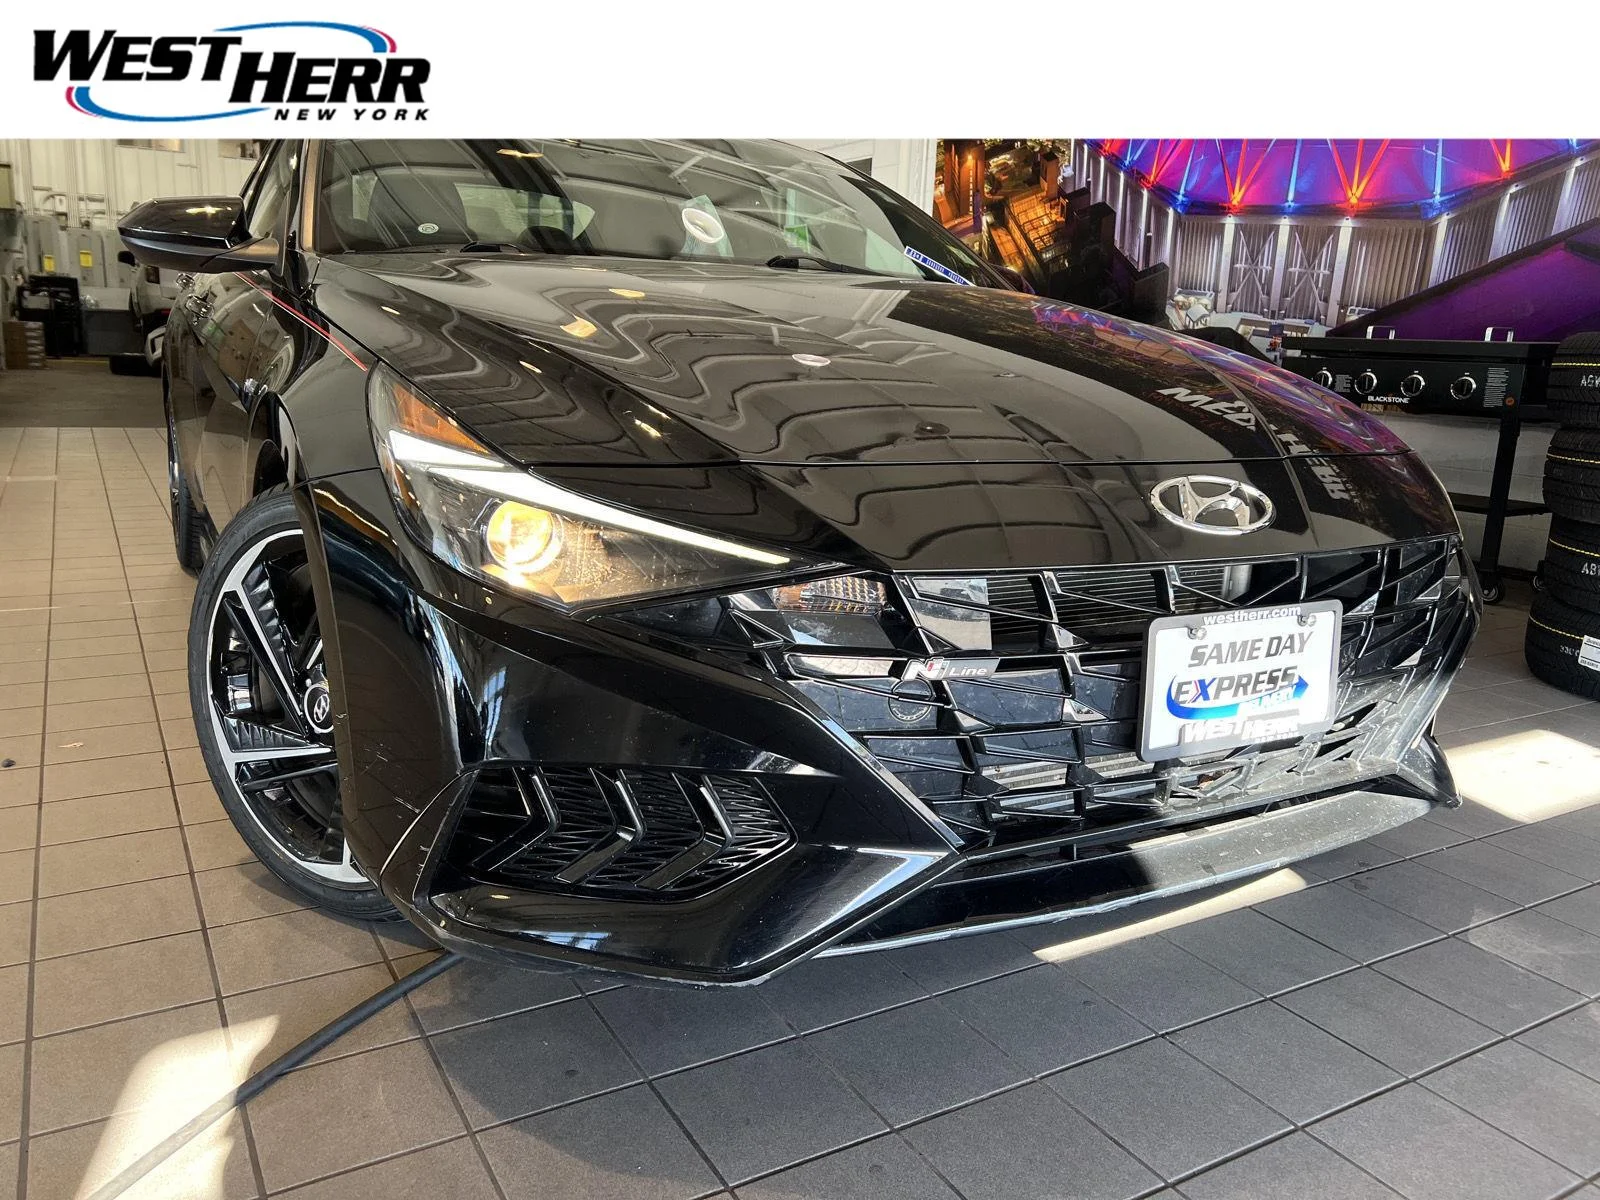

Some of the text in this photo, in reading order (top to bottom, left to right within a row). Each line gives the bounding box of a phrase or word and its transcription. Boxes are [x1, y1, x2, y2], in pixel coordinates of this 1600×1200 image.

[1367, 395, 1411, 404] BLACKSTONE
[1203, 606, 1301, 626] westherr.com
[1187, 631, 1314, 669] SAME DAY
[949, 666, 988, 677] Line
[1173, 665, 1299, 705] EXPRESS
[1184, 719, 1245, 743] WEST
